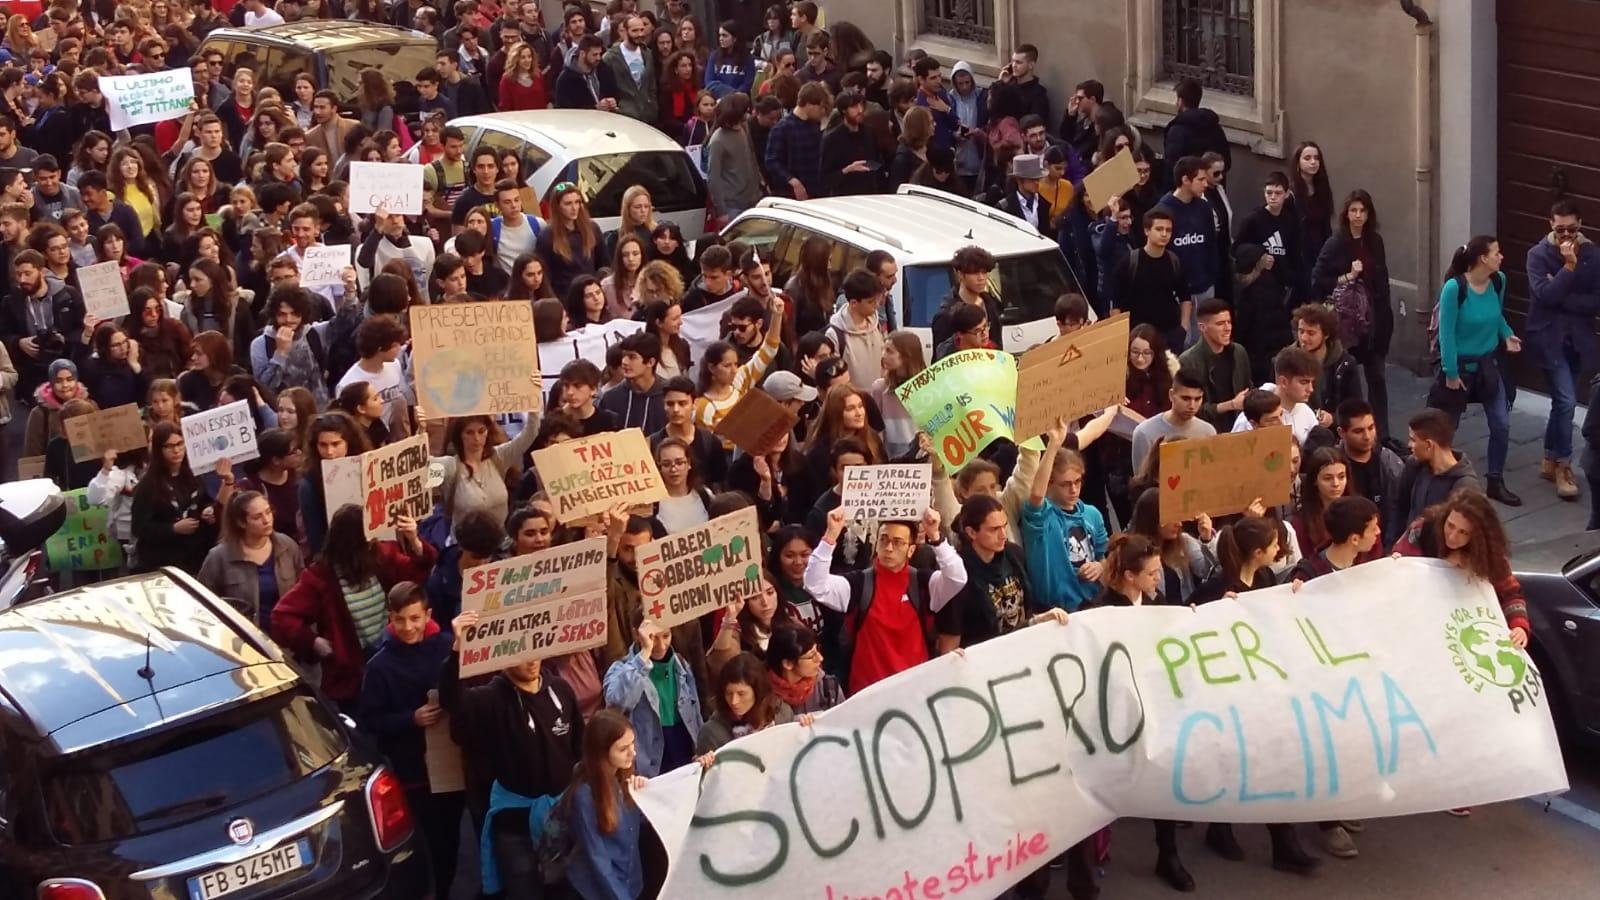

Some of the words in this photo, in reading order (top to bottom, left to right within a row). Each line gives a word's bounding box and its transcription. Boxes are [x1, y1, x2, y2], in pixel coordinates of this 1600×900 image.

[369, 193, 409, 209] ORA!
[417, 303, 531, 329] PRESERVIAMO
[430, 330, 446, 349] IL
[474, 325, 532, 346] GRANDE
[488, 380, 518, 398] CHE
[186, 421, 208, 438] NON
[209, 412, 237, 432] ESISTE
[921, 402, 955, 437] HELP
[240, 426, 253, 444] B
[942, 409, 994, 467] OUR
[573, 441, 613, 464] TAV
[380, 455, 397, 482] PER
[847, 469, 871, 481] LE
[876, 468, 922, 480] PAROLE
[407, 475, 423, 497] PER
[847, 482, 873, 491] NON
[878, 480, 927, 490] SALVANO
[844, 499, 886, 507] BISOGNA
[854, 507, 918, 520] ADESSO
[660, 528, 712, 563] ALBERI
[466, 567, 501, 595] SE
[669, 582, 712, 615] GIORNI
[508, 610, 552, 633] ALTRA
[555, 597, 604, 622] LOTTA
[558, 619, 606, 643] SENSO
[1156, 621, 1288, 699] PER
[1295, 616, 1371, 666] IL
[1445, 622, 1485, 694] FRIDAYS
[1507, 663, 1543, 715] PISA
[1171, 672, 1438, 805] CLIMA
[690, 641, 1146, 887] SCIOPERO
[202, 870, 229, 898] FB
[235, 845, 297, 885] 945MF
